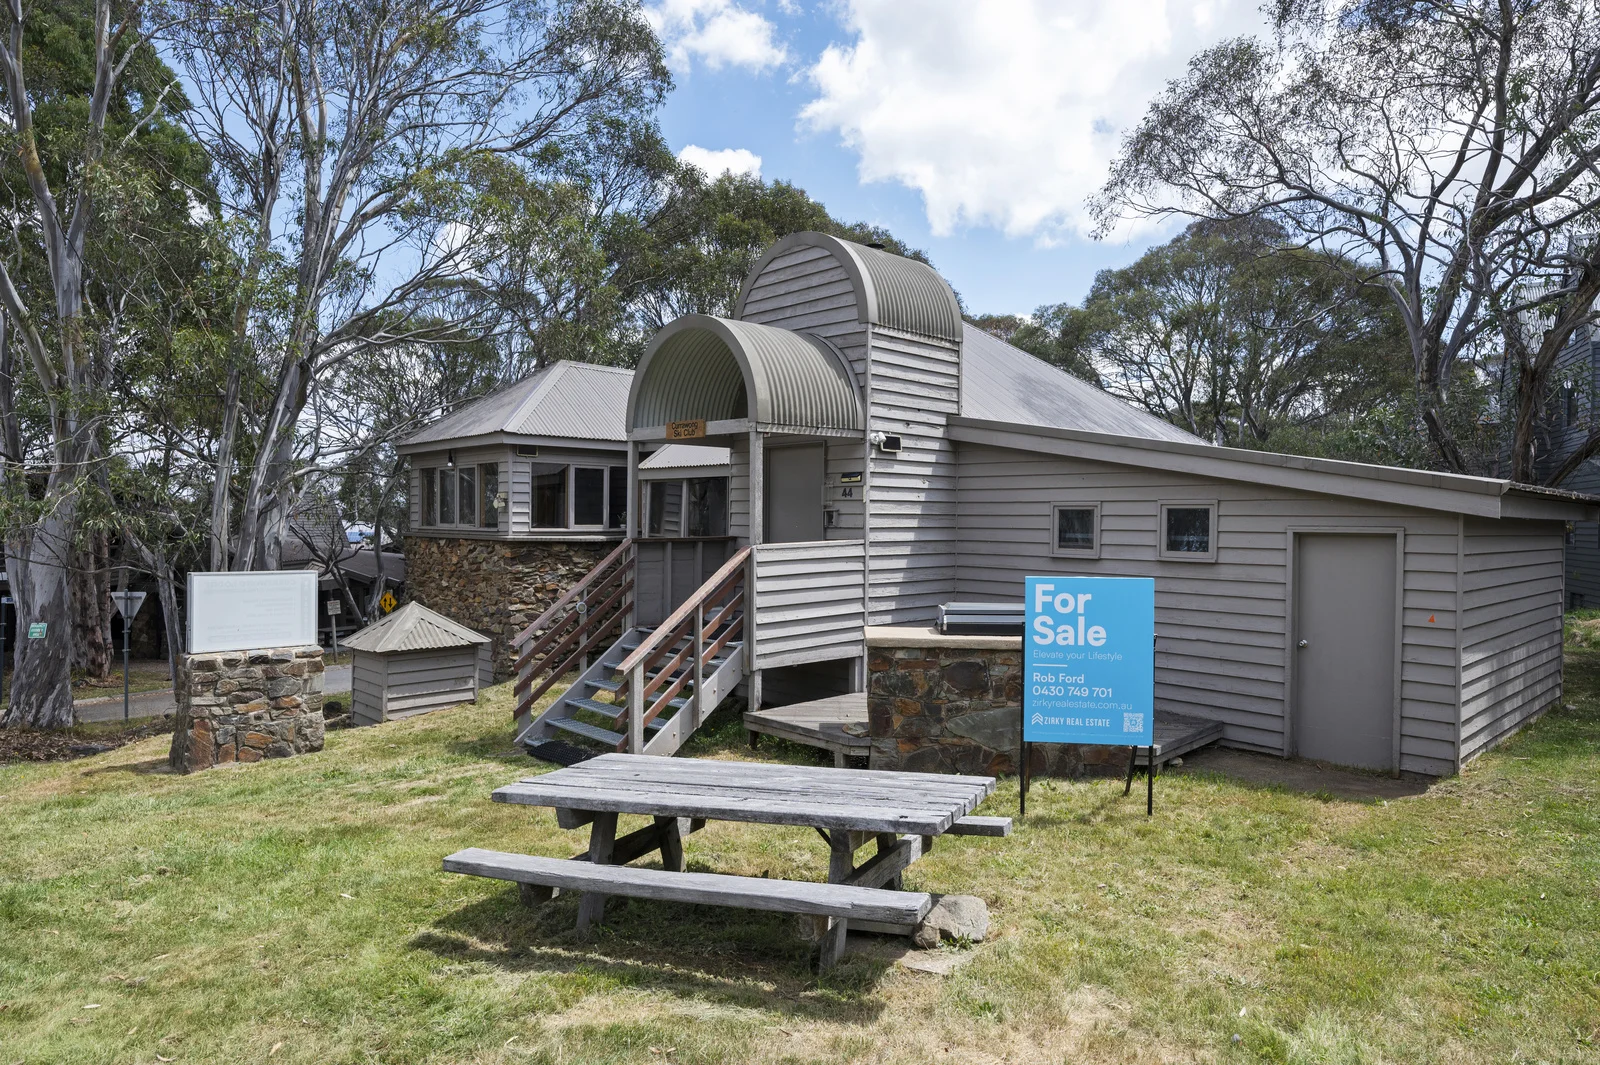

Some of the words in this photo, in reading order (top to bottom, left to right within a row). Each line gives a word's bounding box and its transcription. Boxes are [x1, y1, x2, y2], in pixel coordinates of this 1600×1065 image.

[672, 422, 698, 430] Currawong
[842, 487, 853, 498] 44
[1035, 583, 1092, 614] For
[1033, 615, 1107, 647] Sale
[1033, 649, 1064, 659] Elevate
[1066, 651, 1085, 660] your
[1088, 651, 1123, 661] Lifestyle
[1033, 672, 1056, 683] Rob
[1059, 673, 1085, 684] Ford
[1032, 685, 1065, 696] 0430
[1067, 686, 1089, 697] 749
[1092, 687, 1113, 698] 701
[1032, 699, 1133, 710] zirkyrealestate.com.au
[1043, 716, 1065, 726] ZIRKY
[1066, 717, 1084, 726] REAL
[1085, 718, 1111, 727] ESTATE
